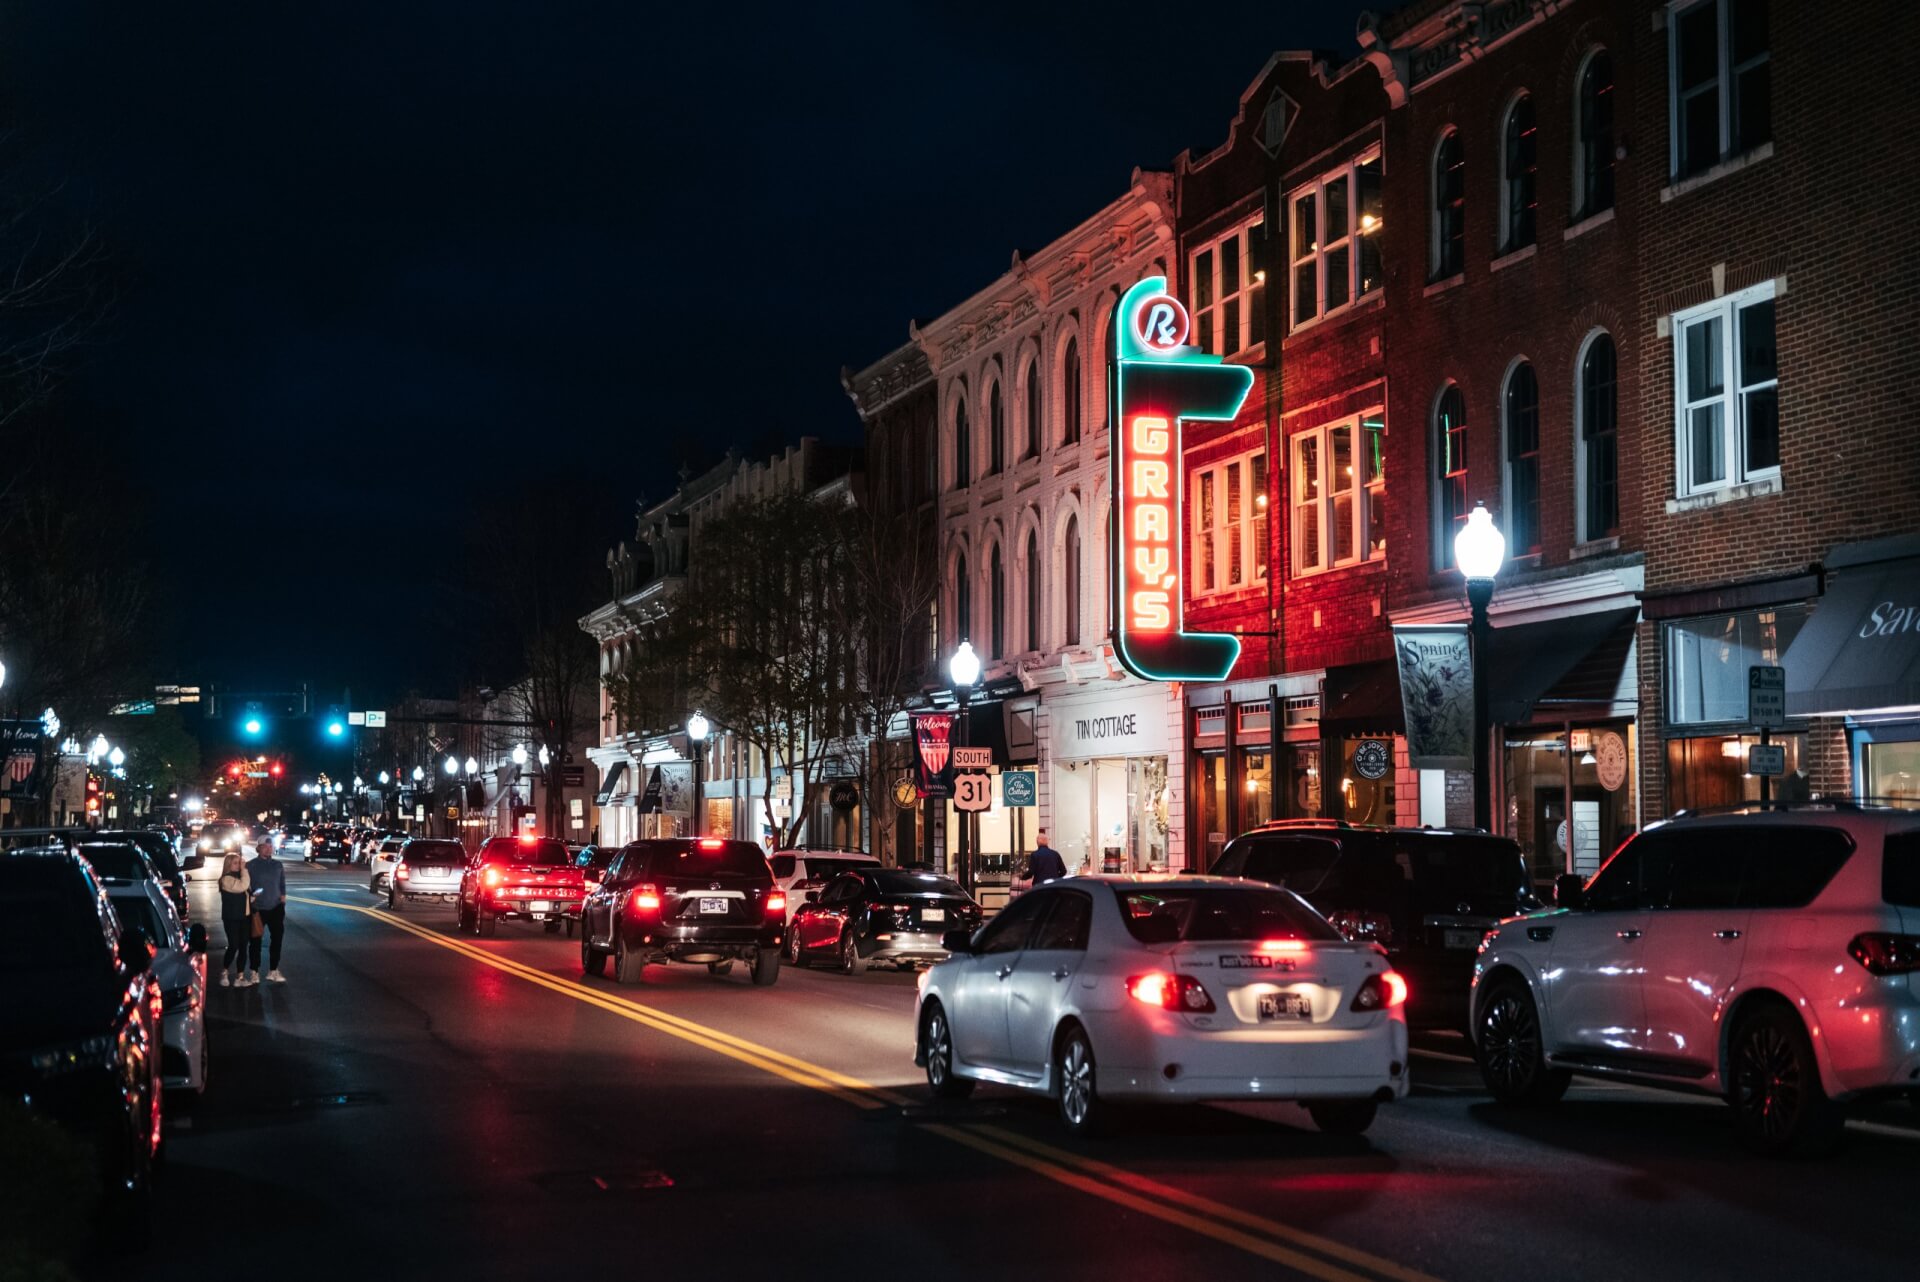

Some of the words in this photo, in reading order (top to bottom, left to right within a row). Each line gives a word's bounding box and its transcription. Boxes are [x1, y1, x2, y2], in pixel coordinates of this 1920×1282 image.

[1132, 416, 1176, 630] GRAY'S
[1859, 602, 1920, 638] Sav
[1405, 640, 1462, 670] Spring
[1752, 671, 1760, 686] 2
[368, 713, 377, 724] P
[915, 717, 952, 730] Welcome
[1075, 720, 1091, 740] TIN
[1092, 713, 1137, 739] COTTAGE
[956, 751, 989, 763] SOUTH
[1367, 742, 1388, 761] JOYFUL
[961, 780, 983, 802] 31
